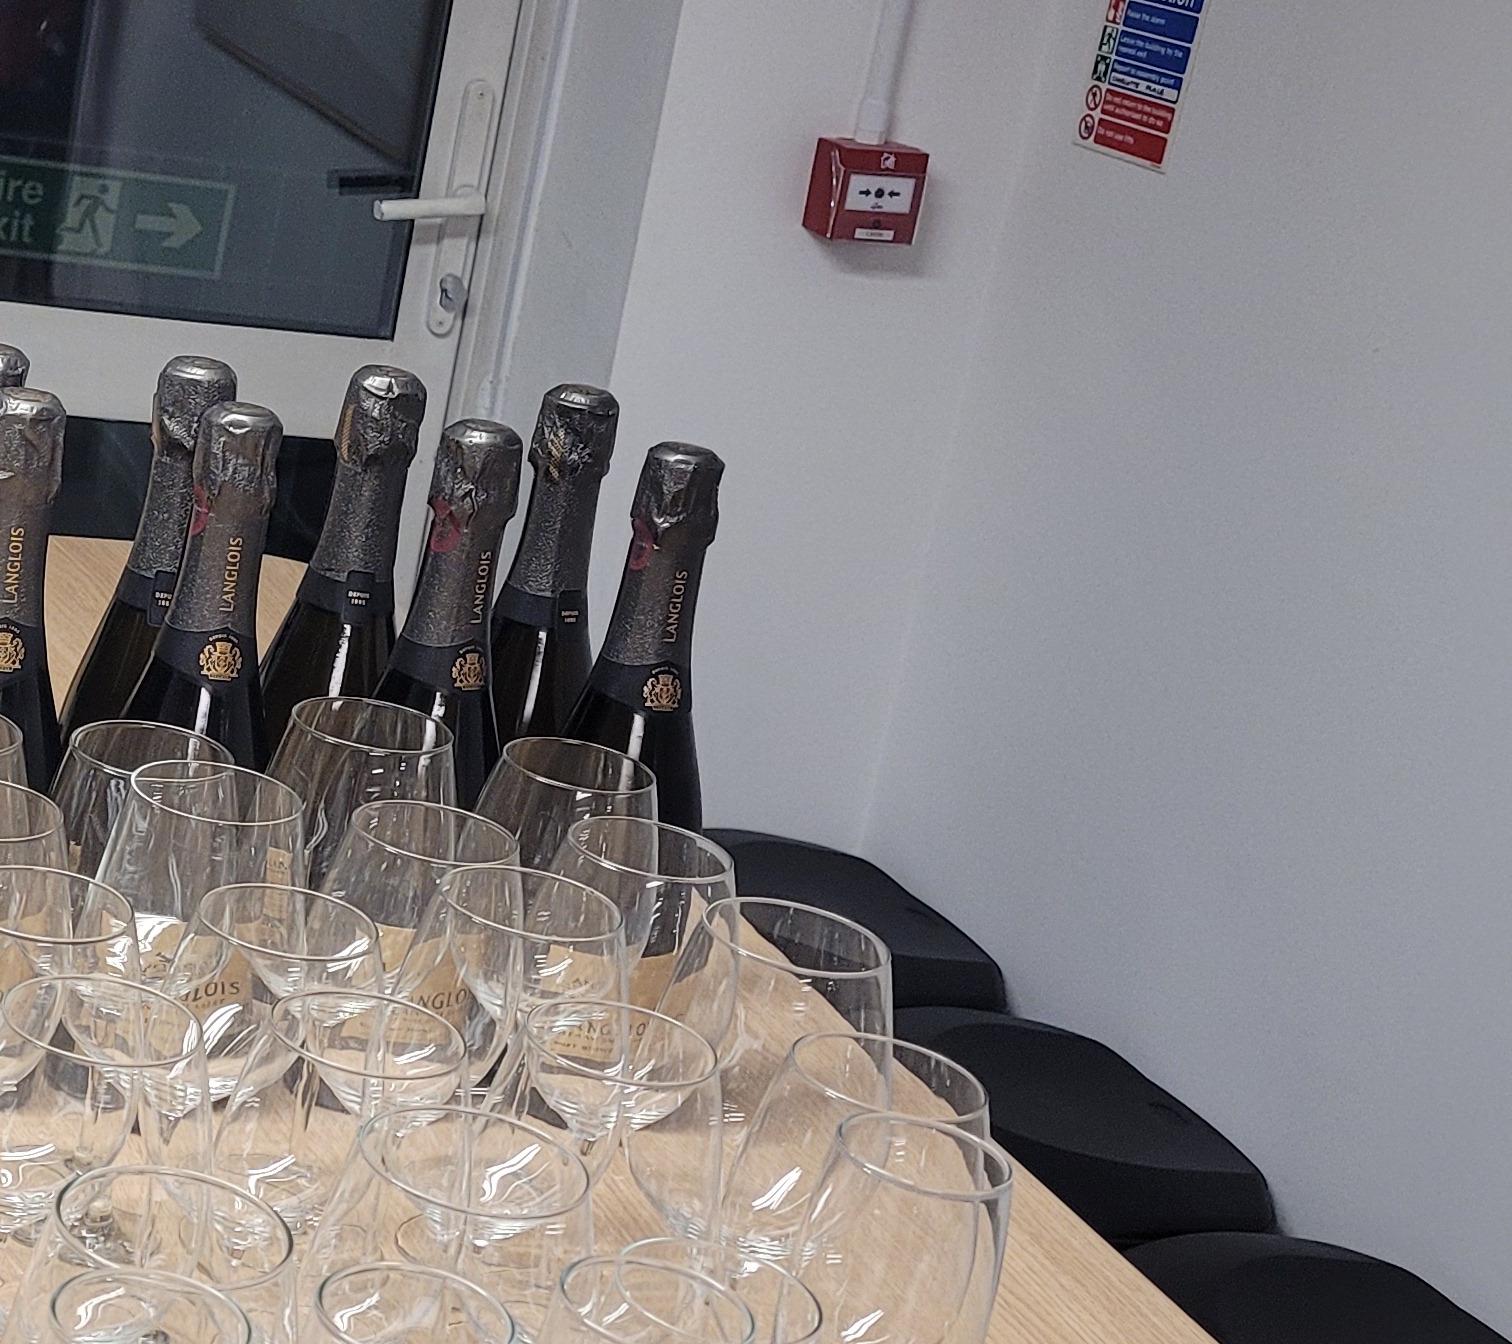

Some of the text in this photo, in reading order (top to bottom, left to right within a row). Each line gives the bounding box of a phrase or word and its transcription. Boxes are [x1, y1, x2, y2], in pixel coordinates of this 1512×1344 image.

[2, 526, 25, 605] LANGLOIS
[219, 536, 244, 612] LANGLOIS
[470, 551, 492, 624] LANGLOIS
[663, 570, 689, 643] LANGLOIS
